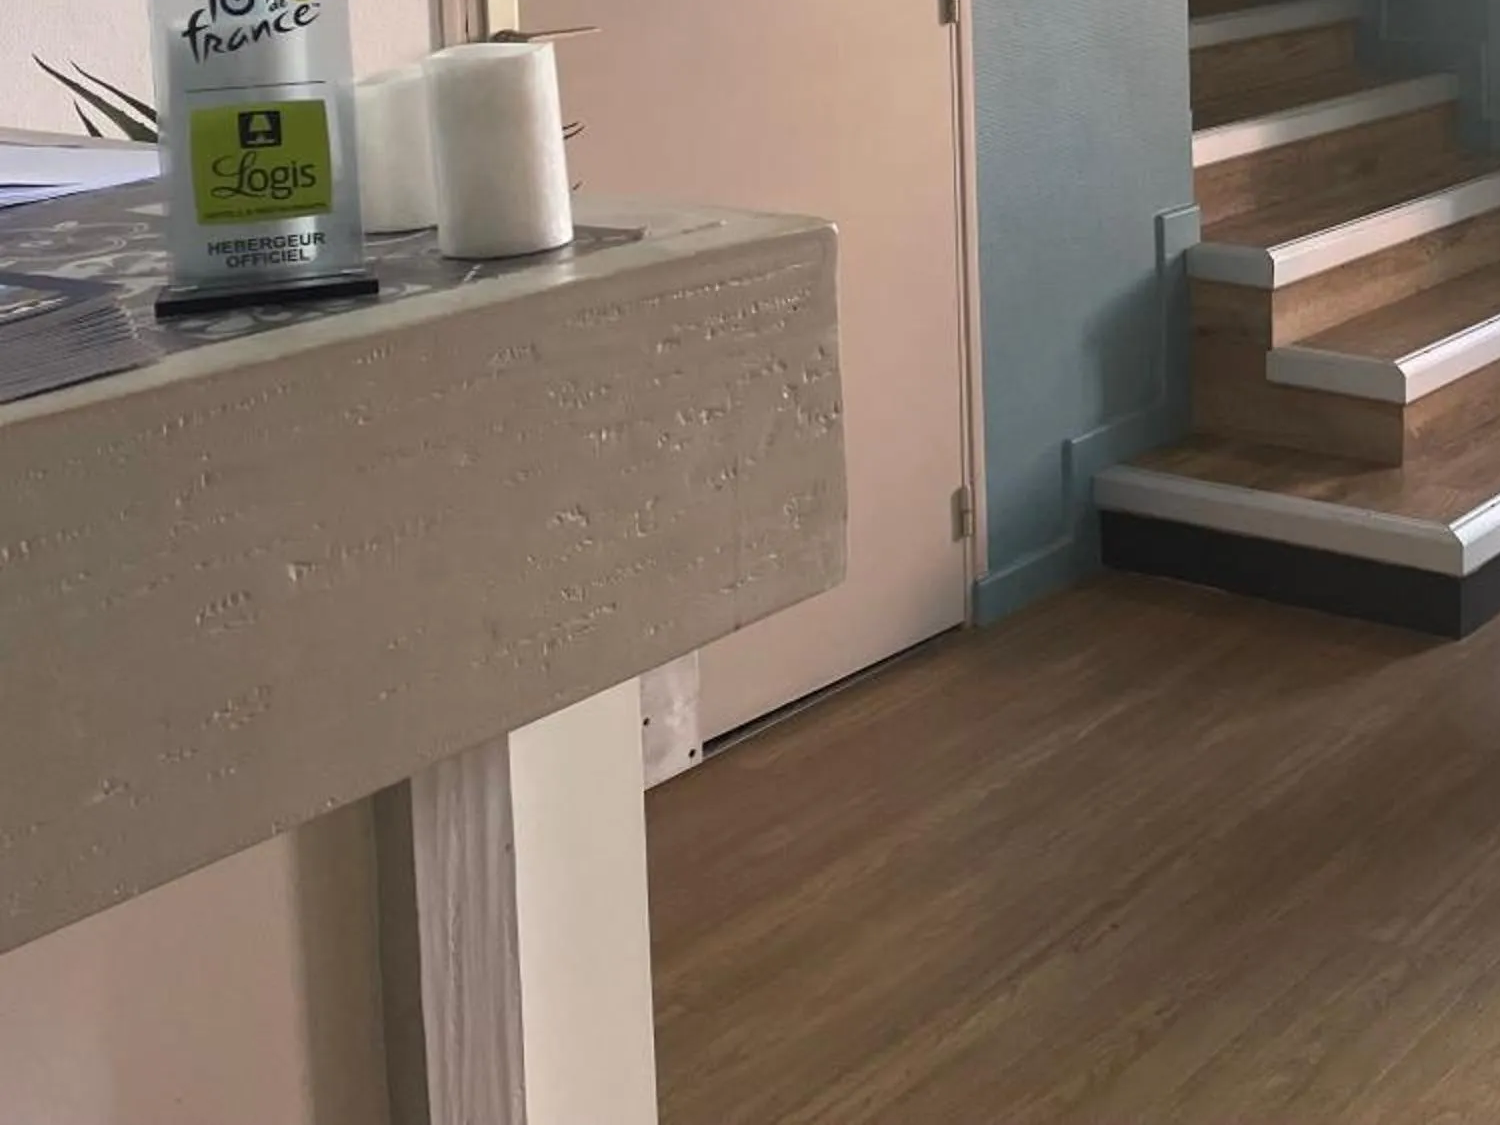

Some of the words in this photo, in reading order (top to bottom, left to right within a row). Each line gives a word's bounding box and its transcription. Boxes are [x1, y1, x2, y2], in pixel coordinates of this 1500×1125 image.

[210, 150, 317, 200] Logis
[207, 232, 326, 256] HEBERGEUR
[225, 248, 311, 268] OFFICIEL
